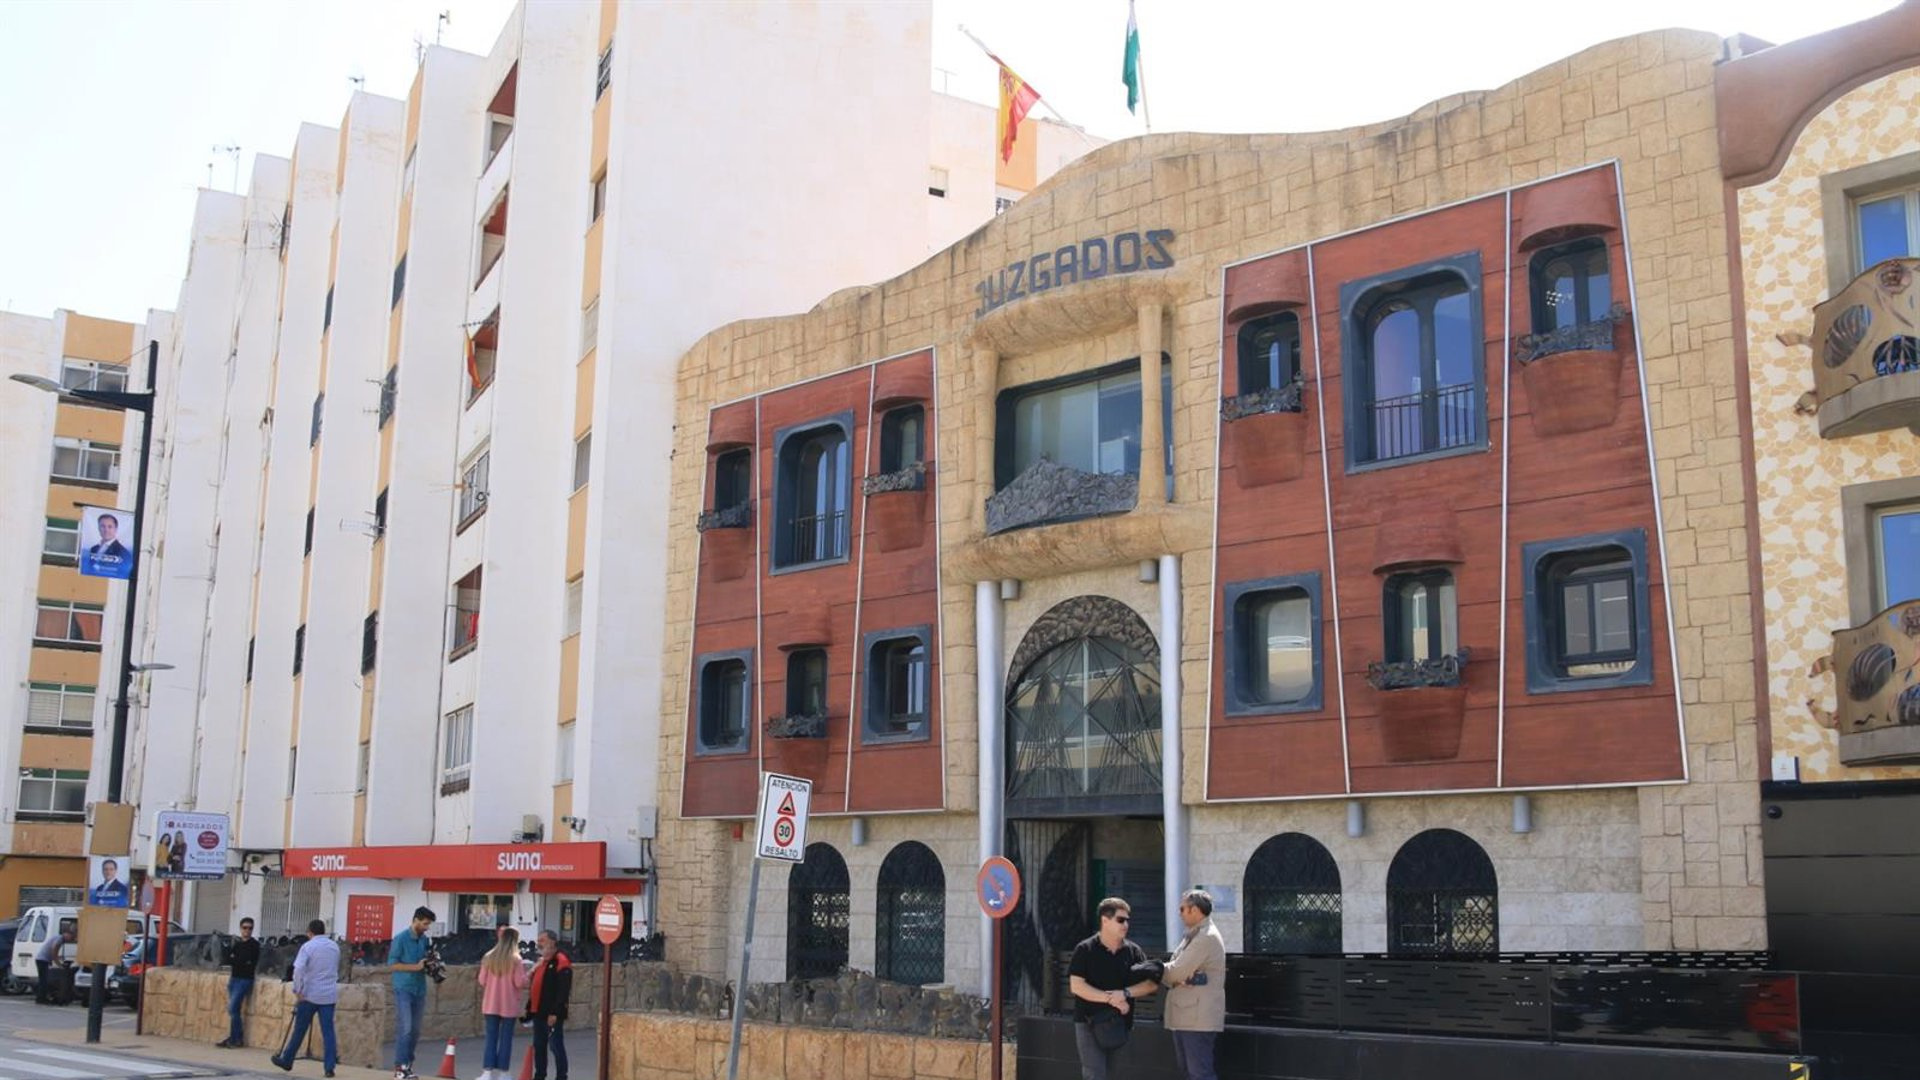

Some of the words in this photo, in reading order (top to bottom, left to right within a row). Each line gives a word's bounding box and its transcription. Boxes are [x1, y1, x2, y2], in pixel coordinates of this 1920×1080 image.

[975, 229, 1175, 319] JUZGADOS
[778, 825, 791, 838] 30
[765, 846, 798, 858] RESALTO
